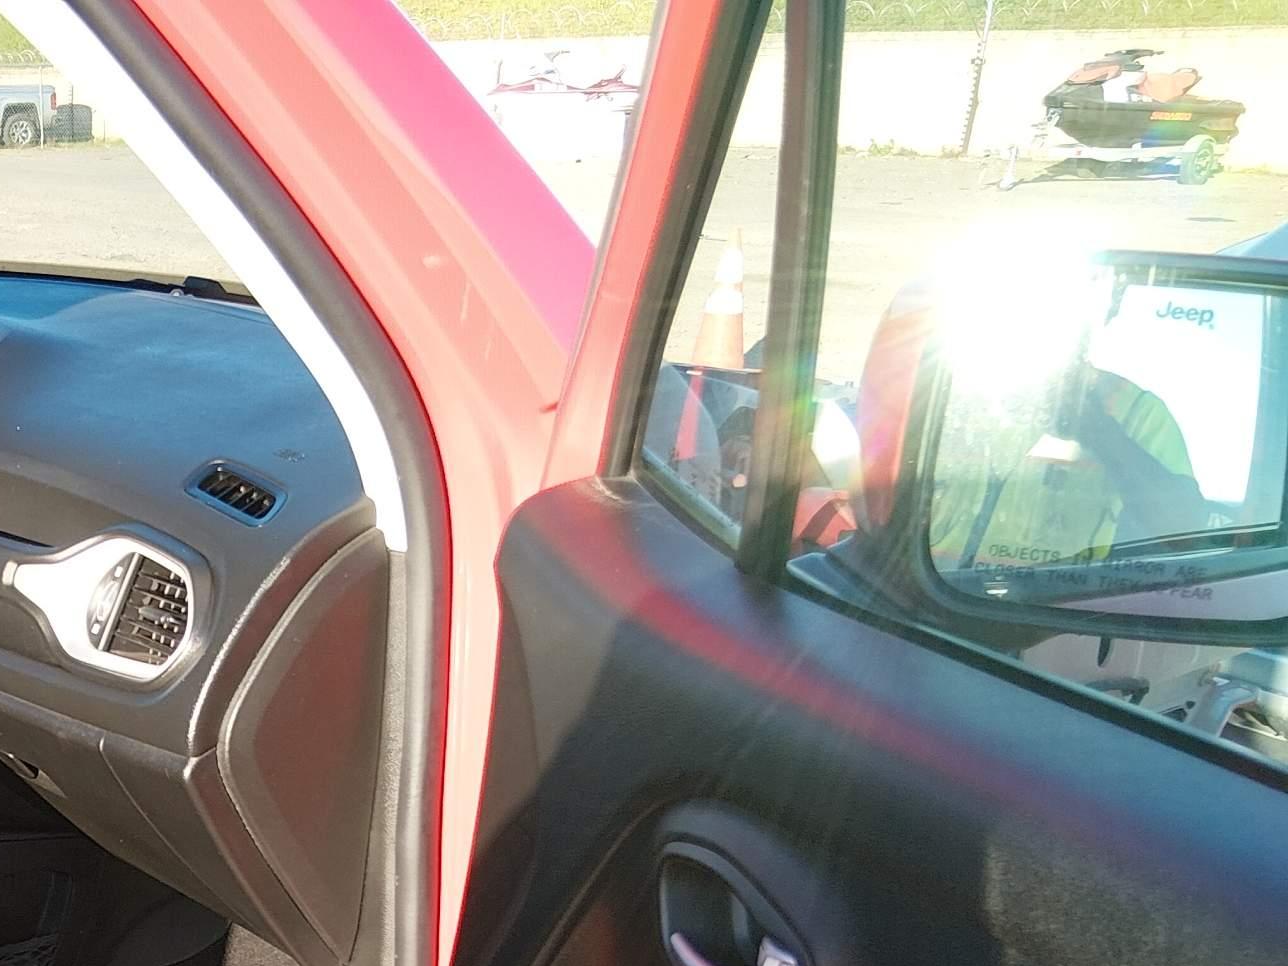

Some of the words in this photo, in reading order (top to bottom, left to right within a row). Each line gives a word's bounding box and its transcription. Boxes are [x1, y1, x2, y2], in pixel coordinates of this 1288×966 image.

[1156, 300, 1214, 327] Jeep
[988, 544, 1061, 562] OBJECTS
[974, 561, 1035, 578] CLOSER
[1149, 582, 1213, 600] PEAR
